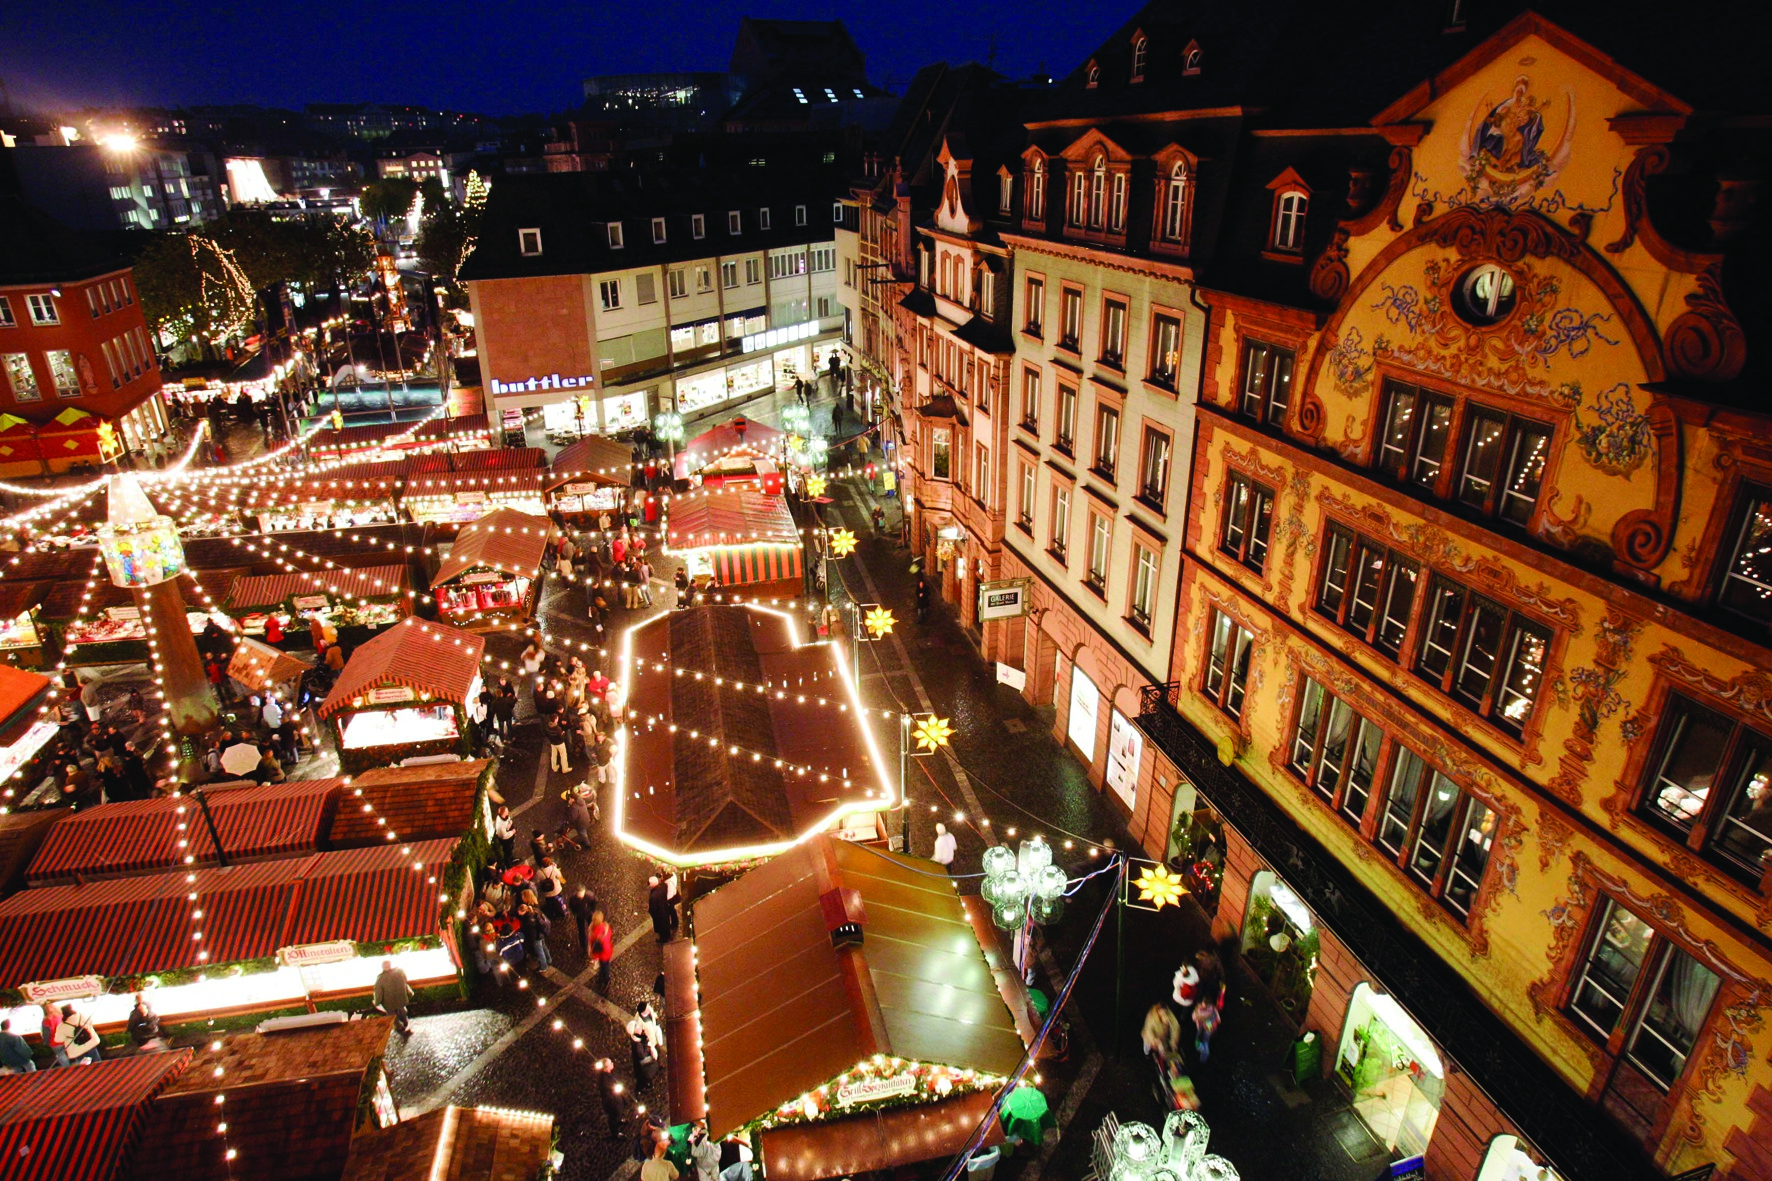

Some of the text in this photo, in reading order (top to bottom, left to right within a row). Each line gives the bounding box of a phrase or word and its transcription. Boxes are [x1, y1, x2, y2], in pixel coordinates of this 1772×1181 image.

[491, 374, 593, 394] buttler
[990, 593, 1015, 603] GALERIE
[32, 981, 98, 996] Schmuck
